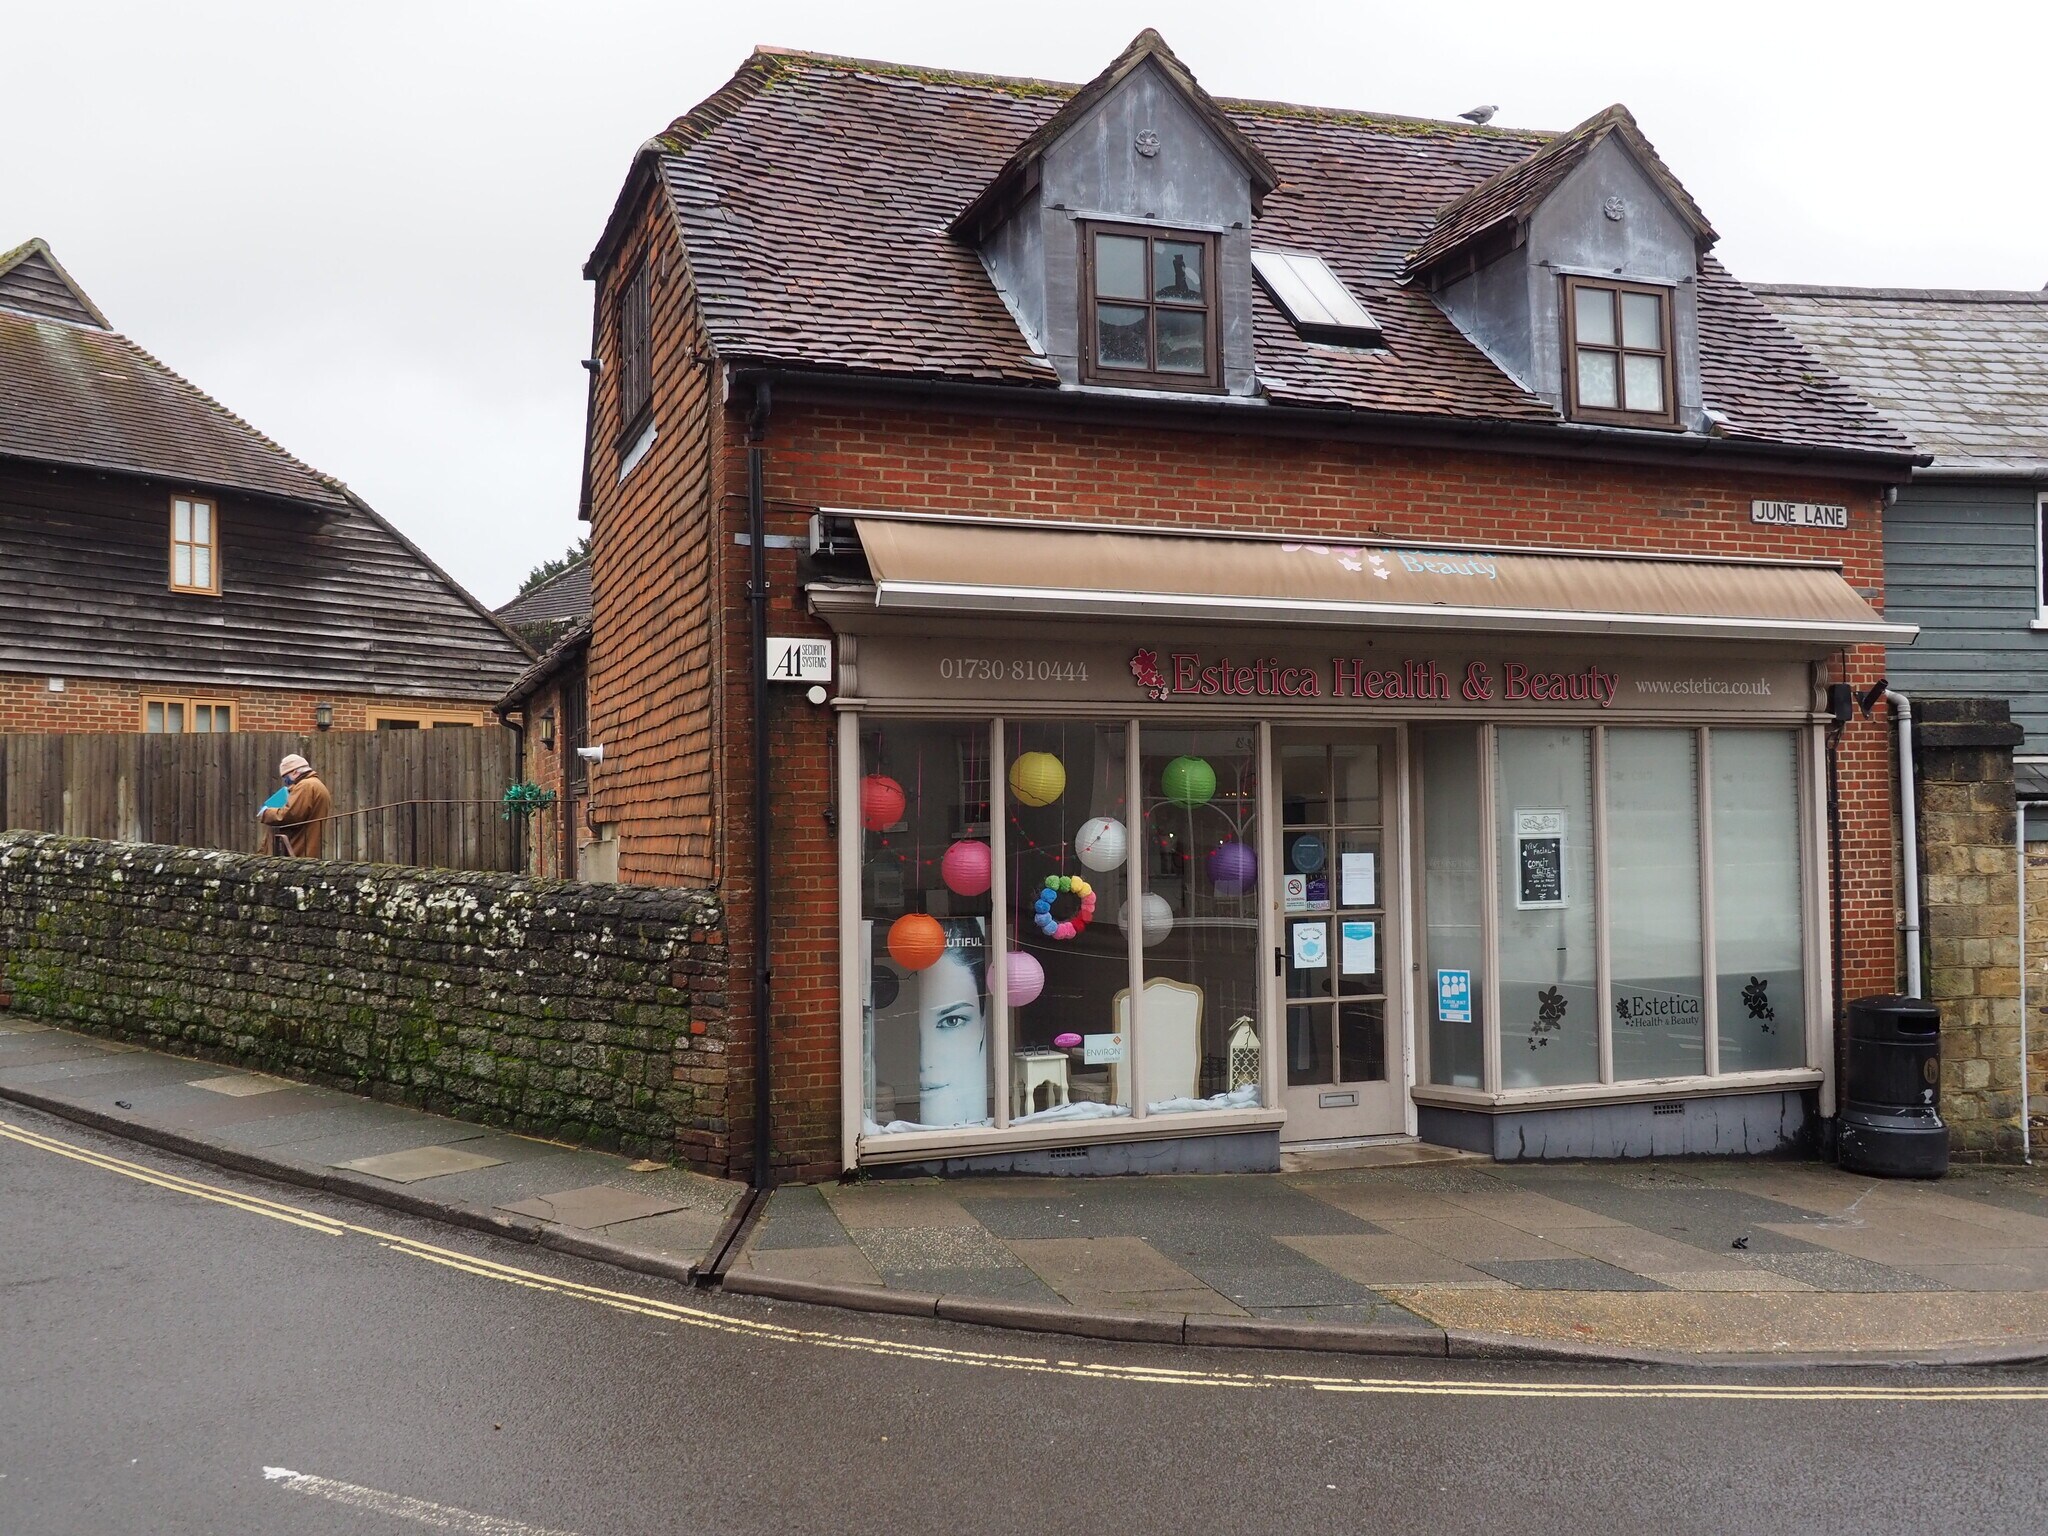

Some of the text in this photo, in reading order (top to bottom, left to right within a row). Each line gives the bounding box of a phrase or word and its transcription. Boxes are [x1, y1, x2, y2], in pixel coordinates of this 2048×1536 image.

[1756, 502, 1844, 526] JUNE LANE
[1399, 554, 1497, 580] Beauty
[802, 644, 827, 656] SECURITY
[772, 644, 803, 677] A1
[802, 656, 827, 668] SYSTEMS
[1171, 653, 1619, 708] Estetica Health & Beauty
[1635, 677, 1772, 696] www.estetica.co.uk
[944, 937, 982, 948] UTIFUL
[1632, 994, 1699, 1016] Estetica
[1635, 1016, 1663, 1027] Health
[1671, 1015, 1699, 1026] Beauty
[1086, 1048, 1121, 1056] ENVIRON
